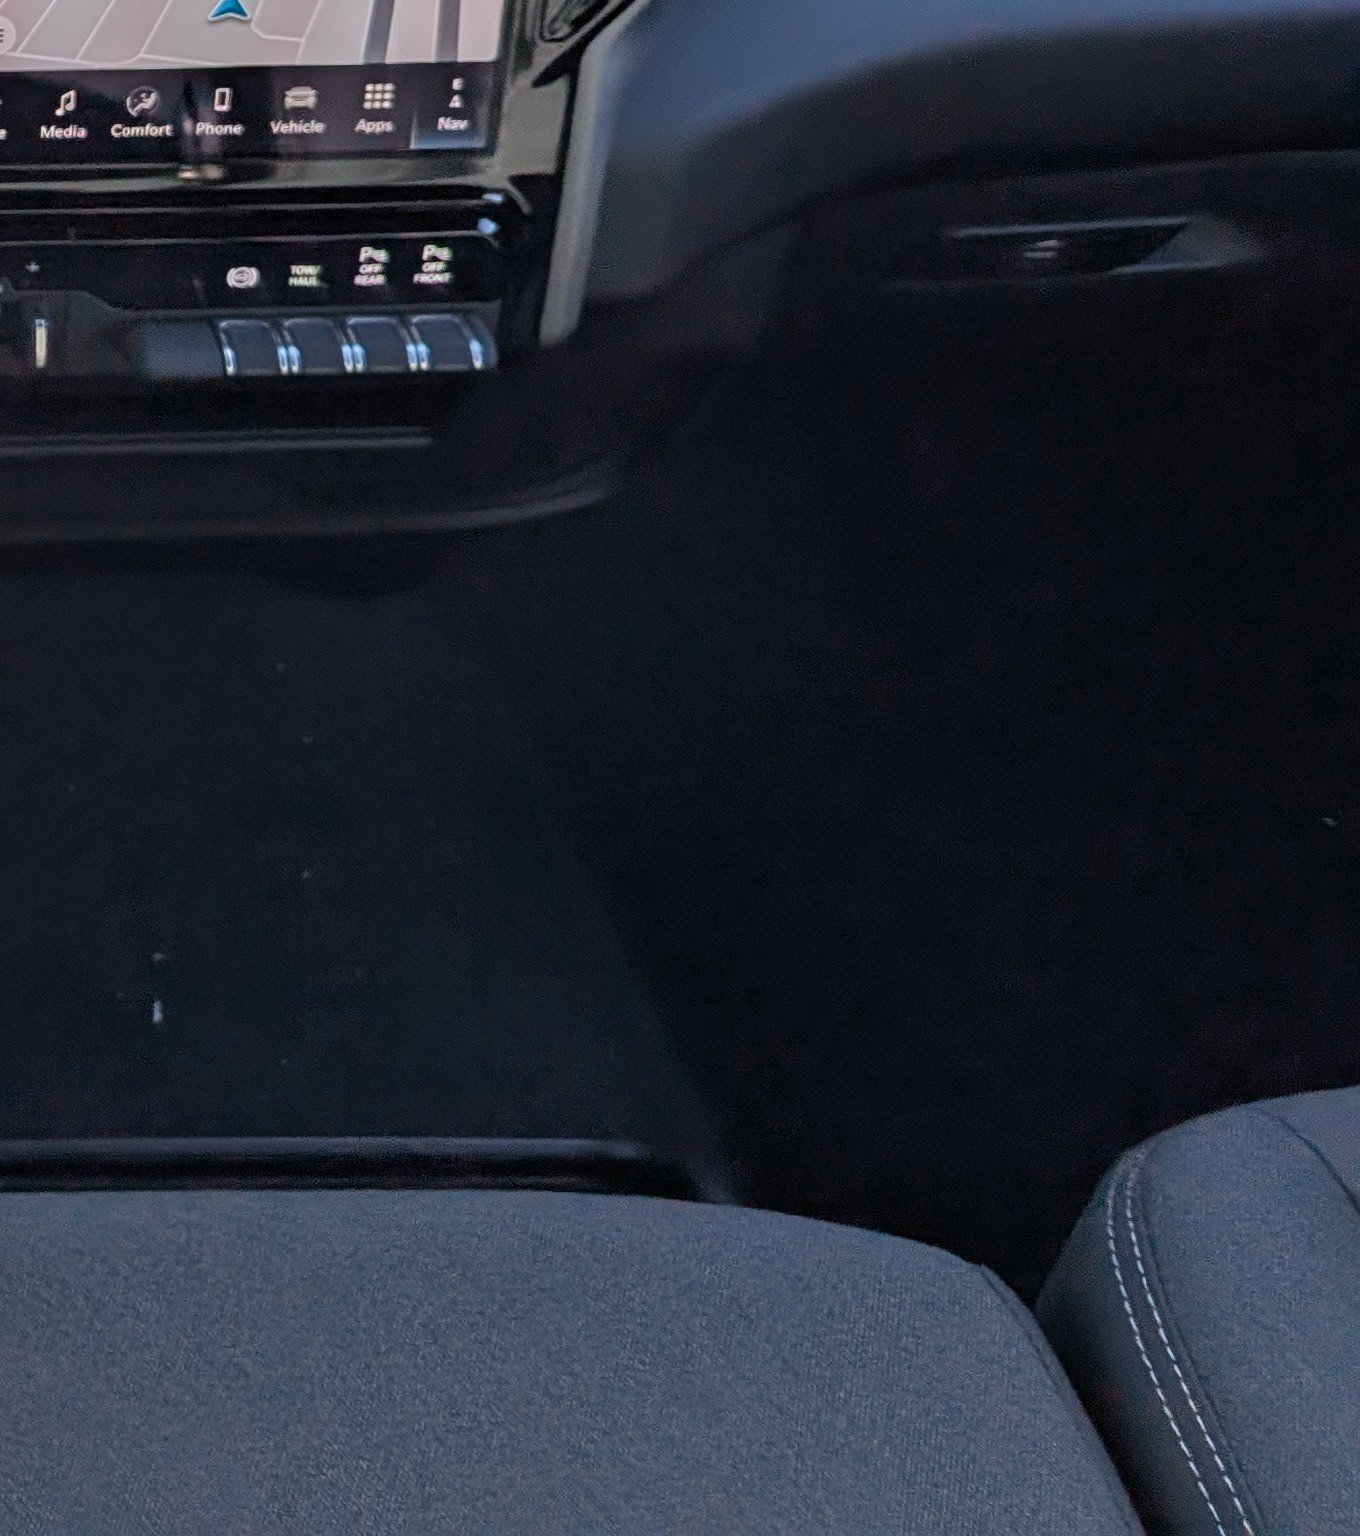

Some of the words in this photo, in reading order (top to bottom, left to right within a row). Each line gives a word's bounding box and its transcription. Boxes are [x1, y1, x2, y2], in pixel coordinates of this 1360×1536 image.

[110, 122, 174, 139] Comfort
[195, 121, 244, 136] Phone
[269, 119, 326, 135] Vehicle
[354, 118, 395, 135] Apps
[437, 116, 468, 131] Nav
[39, 124, 87, 140] Media
